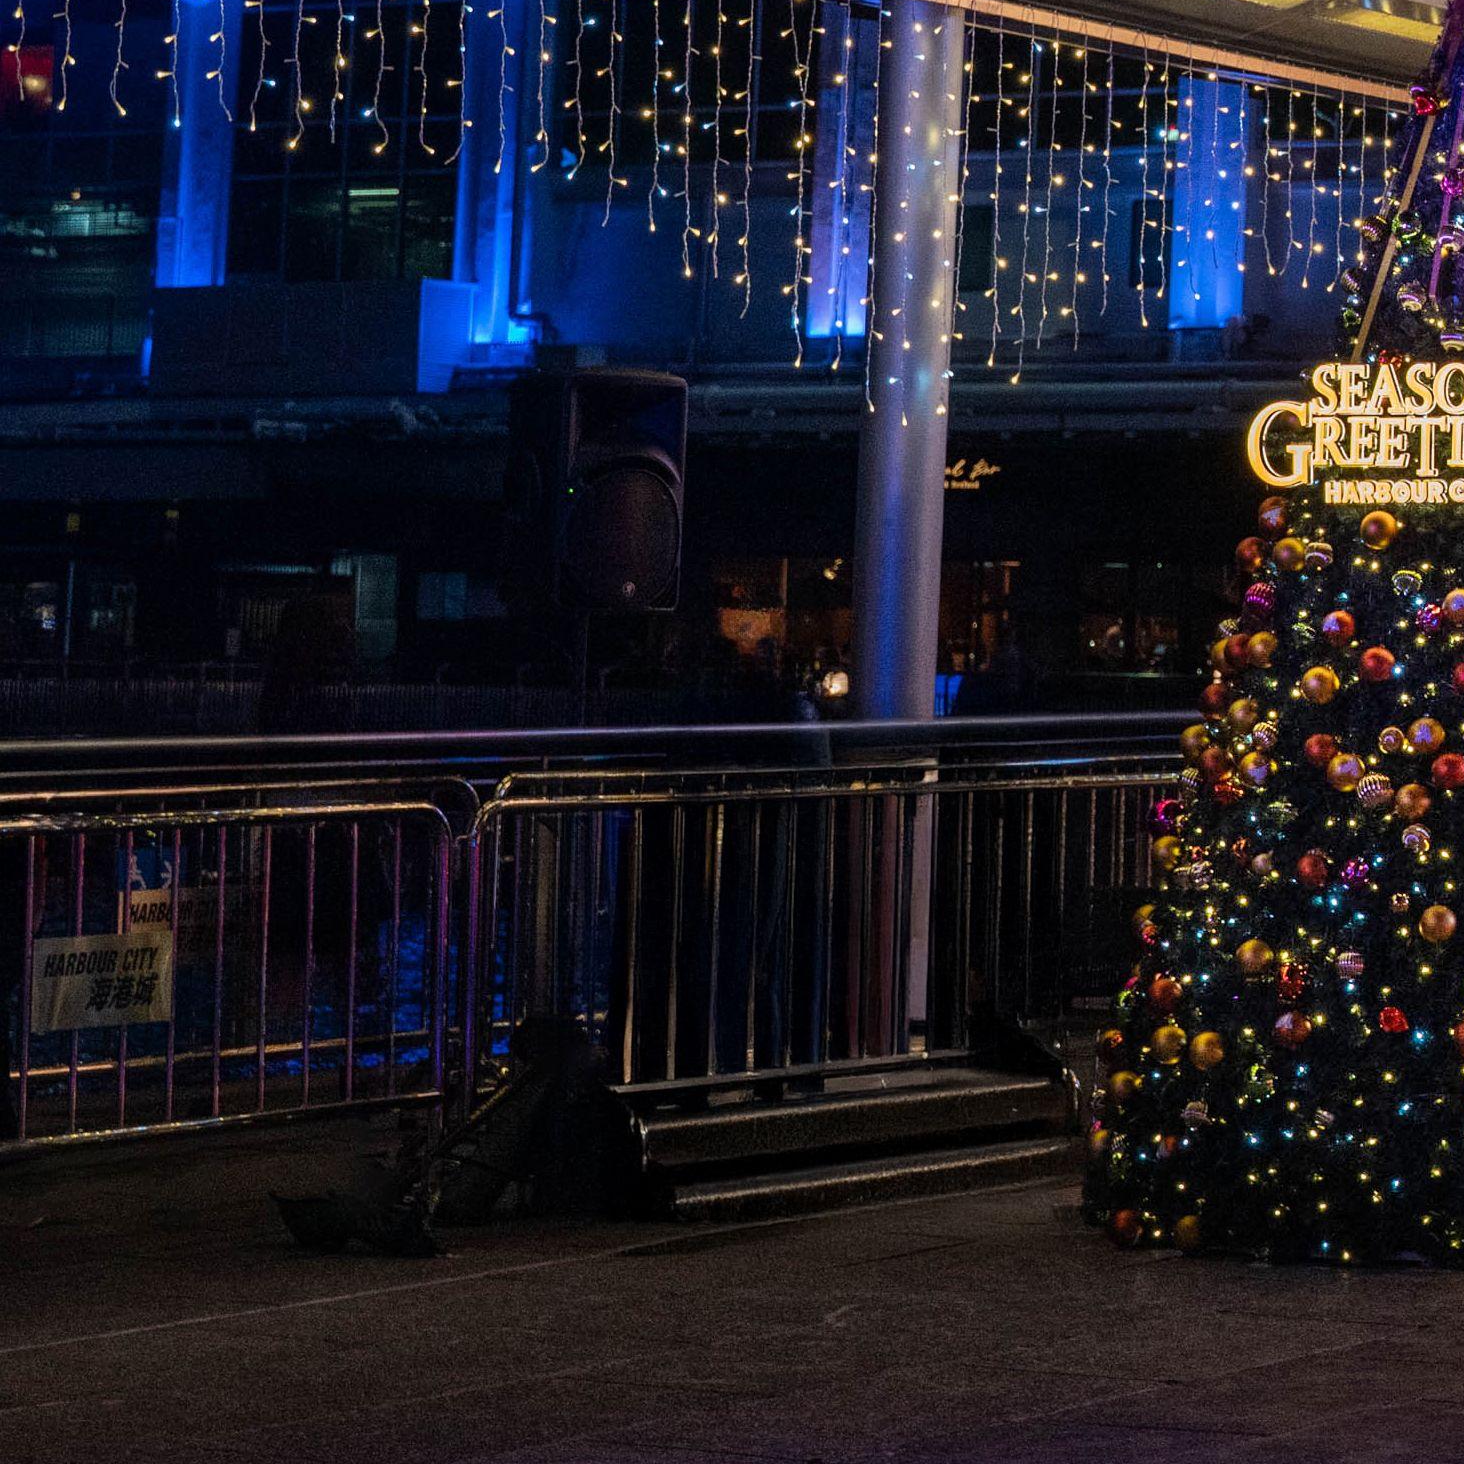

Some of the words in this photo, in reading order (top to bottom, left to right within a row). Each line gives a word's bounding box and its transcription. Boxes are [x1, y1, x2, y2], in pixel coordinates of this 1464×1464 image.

[1324, 480, 1448, 504] HARBOUR
[44, 950, 118, 978] HARBOUR
[122, 946, 159, 974] CITY
